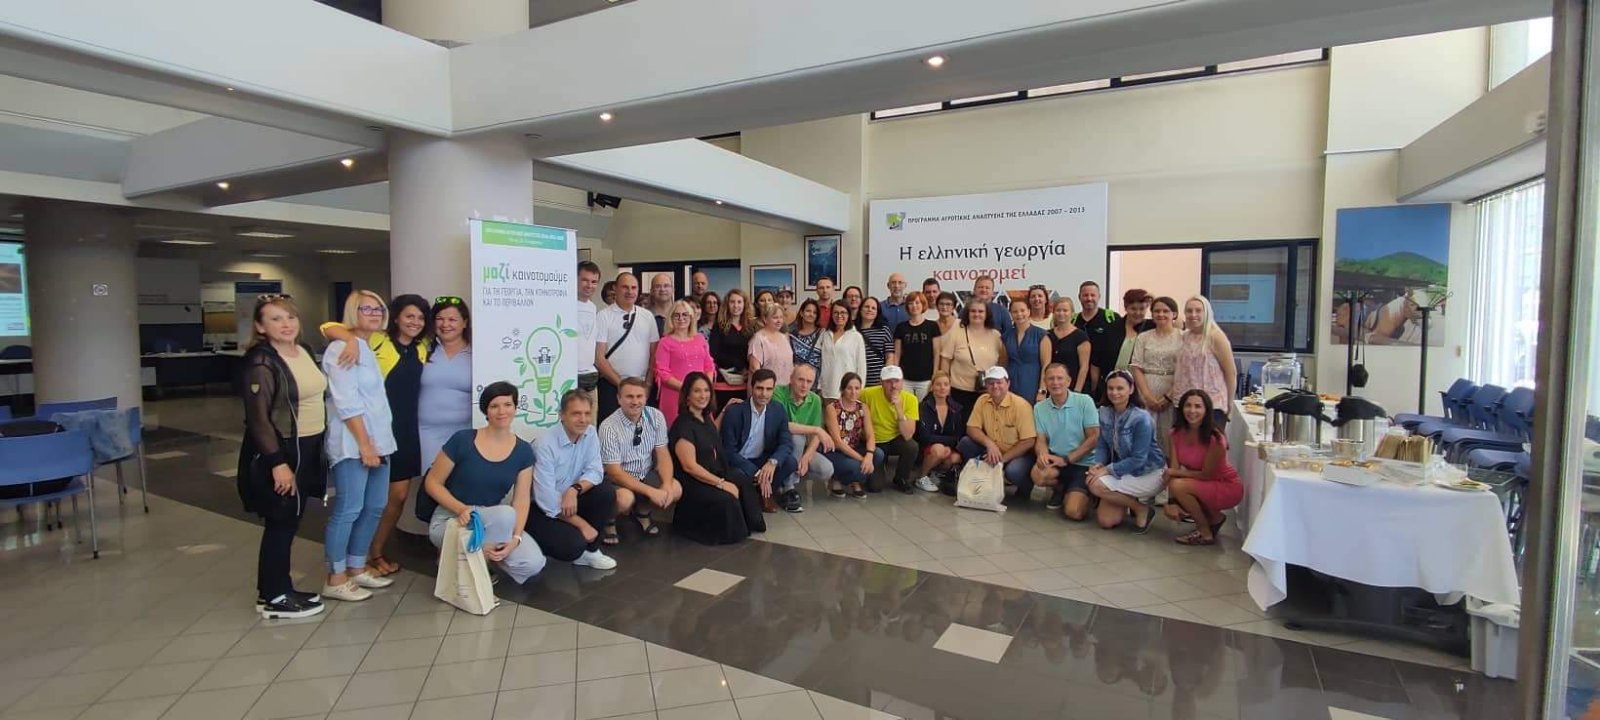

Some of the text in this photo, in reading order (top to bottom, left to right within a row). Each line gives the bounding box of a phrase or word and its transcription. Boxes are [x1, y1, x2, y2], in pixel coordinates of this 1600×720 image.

[907, 216, 940, 224] ΠΡΟΓΡΑΜΜΑ
[941, 214, 970, 222] ΑΓΡΟΤΙΚΗΣ
[972, 211, 1004, 220] ΑΝΑΠΤΥΞΗΣ
[1018, 209, 1045, 217] ΕΛΛΑΔΑΣ
[1069, 206, 1085, 214] 2013
[899, 240, 1066, 262] Η ελληνική γεωργία
[483, 262, 569, 285] μαζί καινοτομούμε
[933, 264, 1027, 284] καινοτομεί
